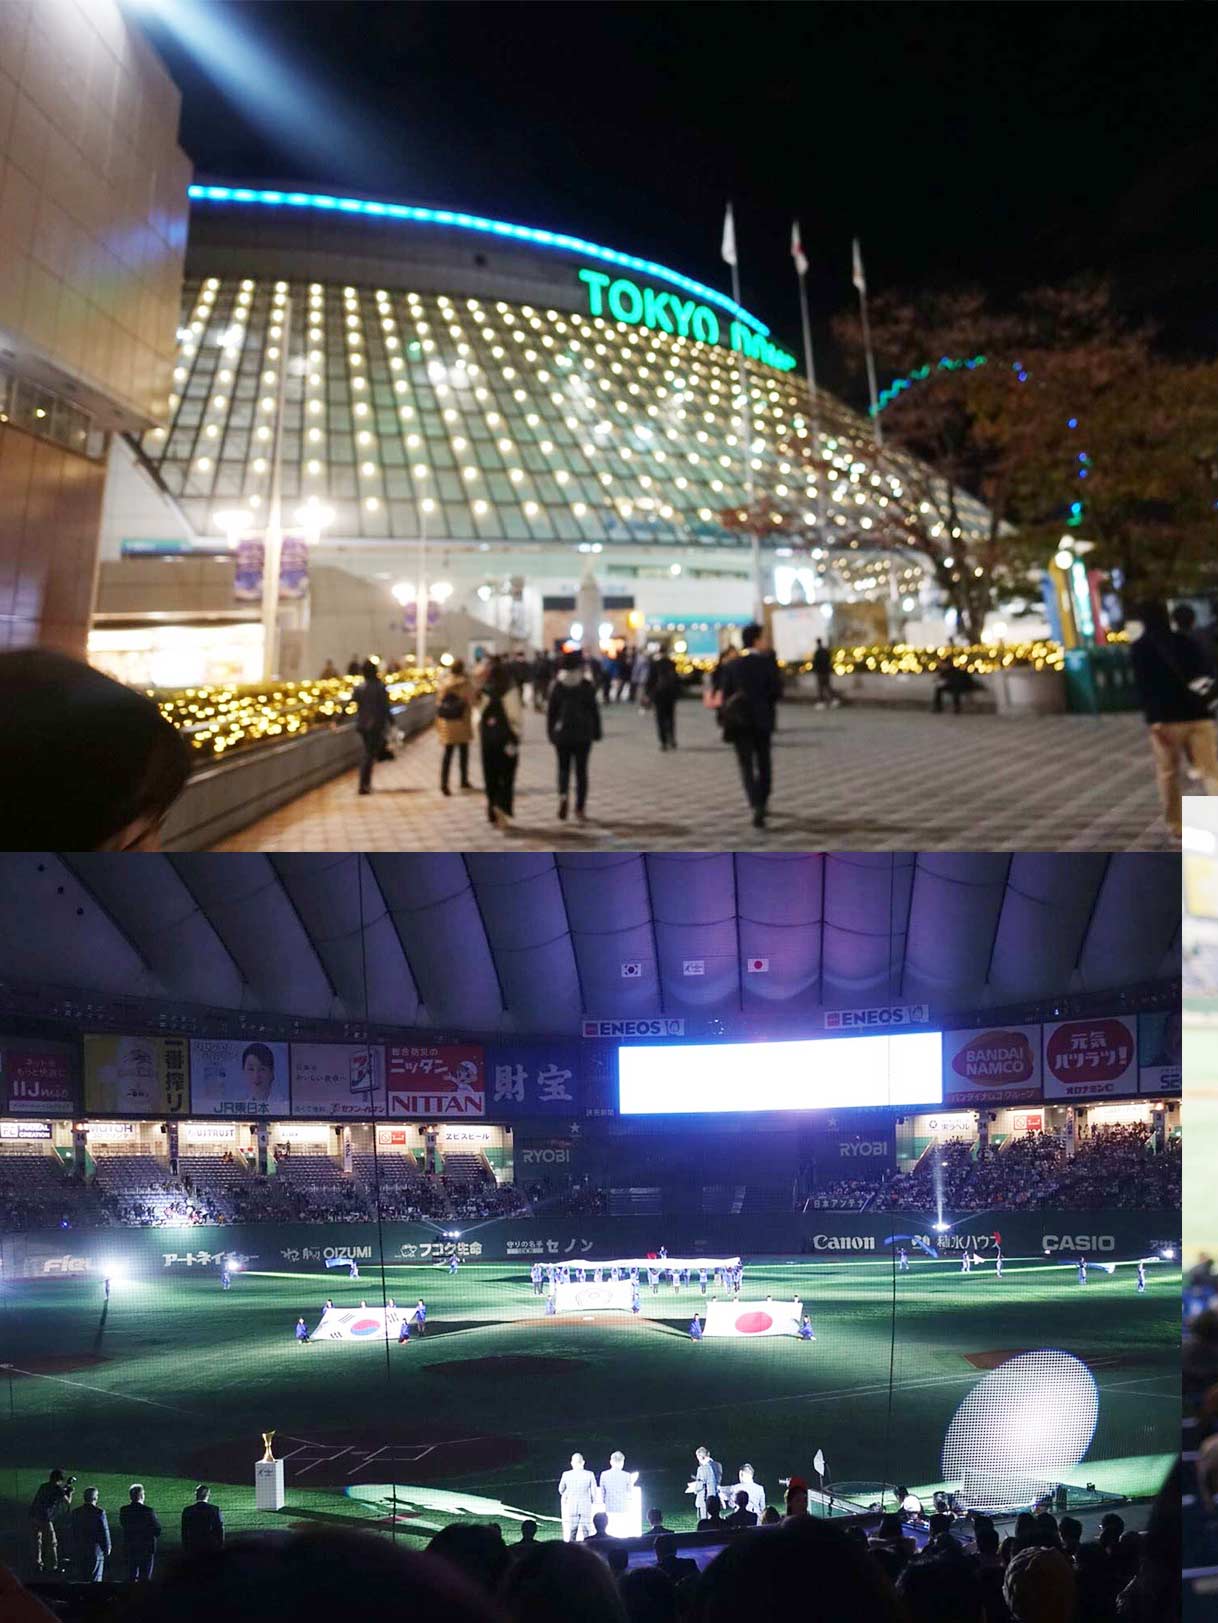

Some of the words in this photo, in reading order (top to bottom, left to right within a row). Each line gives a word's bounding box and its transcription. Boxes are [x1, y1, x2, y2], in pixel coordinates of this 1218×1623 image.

[578, 268, 719, 344] TOKYO
[841, 1008, 904, 1026] ENEOS
[599, 1021, 661, 1035] ENEOS
[1071, 1031, 1107, 1049] 元気
[966, 1047, 1024, 1063] BANDAI
[966, 1060, 1024, 1076] NAMCO
[494, 1064, 573, 1102] 財宝
[1066, 1083, 1114, 1095] オロナミンC
[214, 1102, 270, 1114] JR東日本
[392, 1095, 481, 1113] NITTAN
[522, 1150, 570, 1163] RYOBI
[839, 1142, 887, 1156] RYOBI
[418, 1242, 482, 1257] フコク生命
[812, 1234, 876, 1250] Canon
[1041, 1235, 1115, 1250] CASIO
[323, 1246, 372, 1259] OIZUMI
